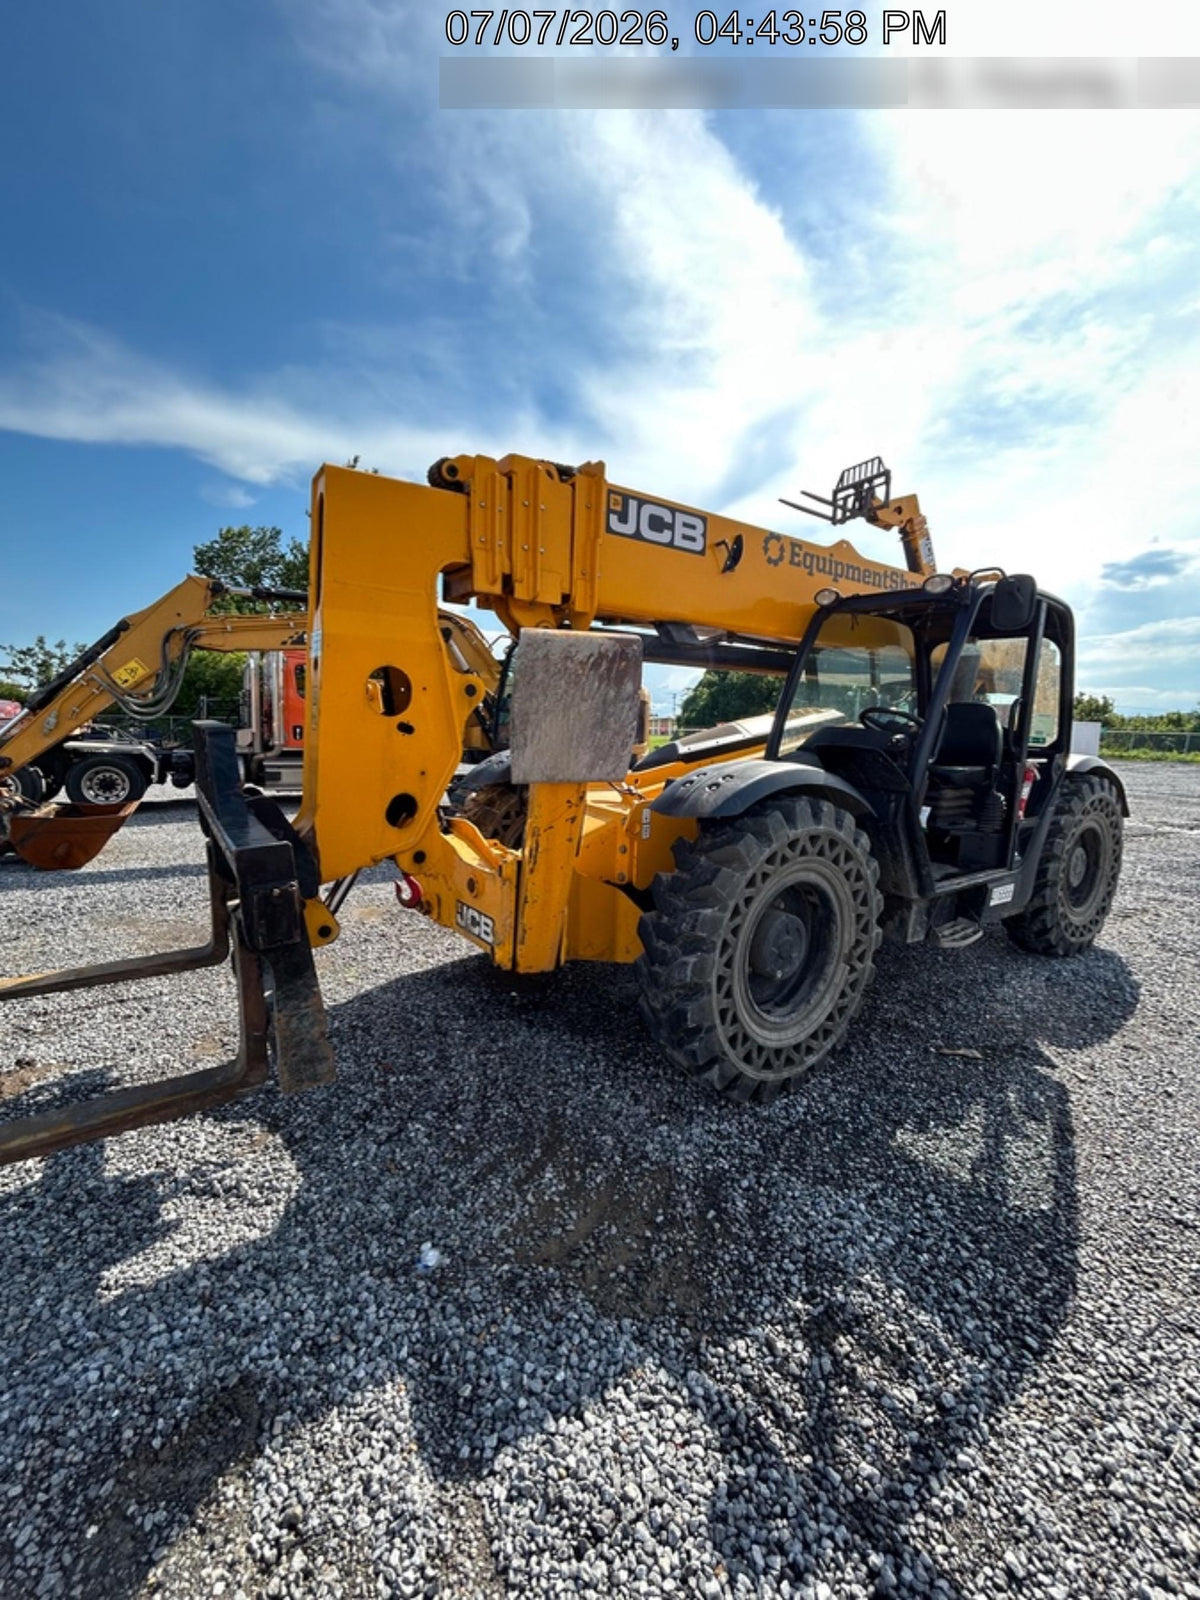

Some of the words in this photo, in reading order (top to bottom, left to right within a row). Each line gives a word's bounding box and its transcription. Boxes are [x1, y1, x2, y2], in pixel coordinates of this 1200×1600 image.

[609, 498, 705, 552] JCB
[789, 541, 923, 590] EquipmentSha
[456, 902, 494, 944] JCB
